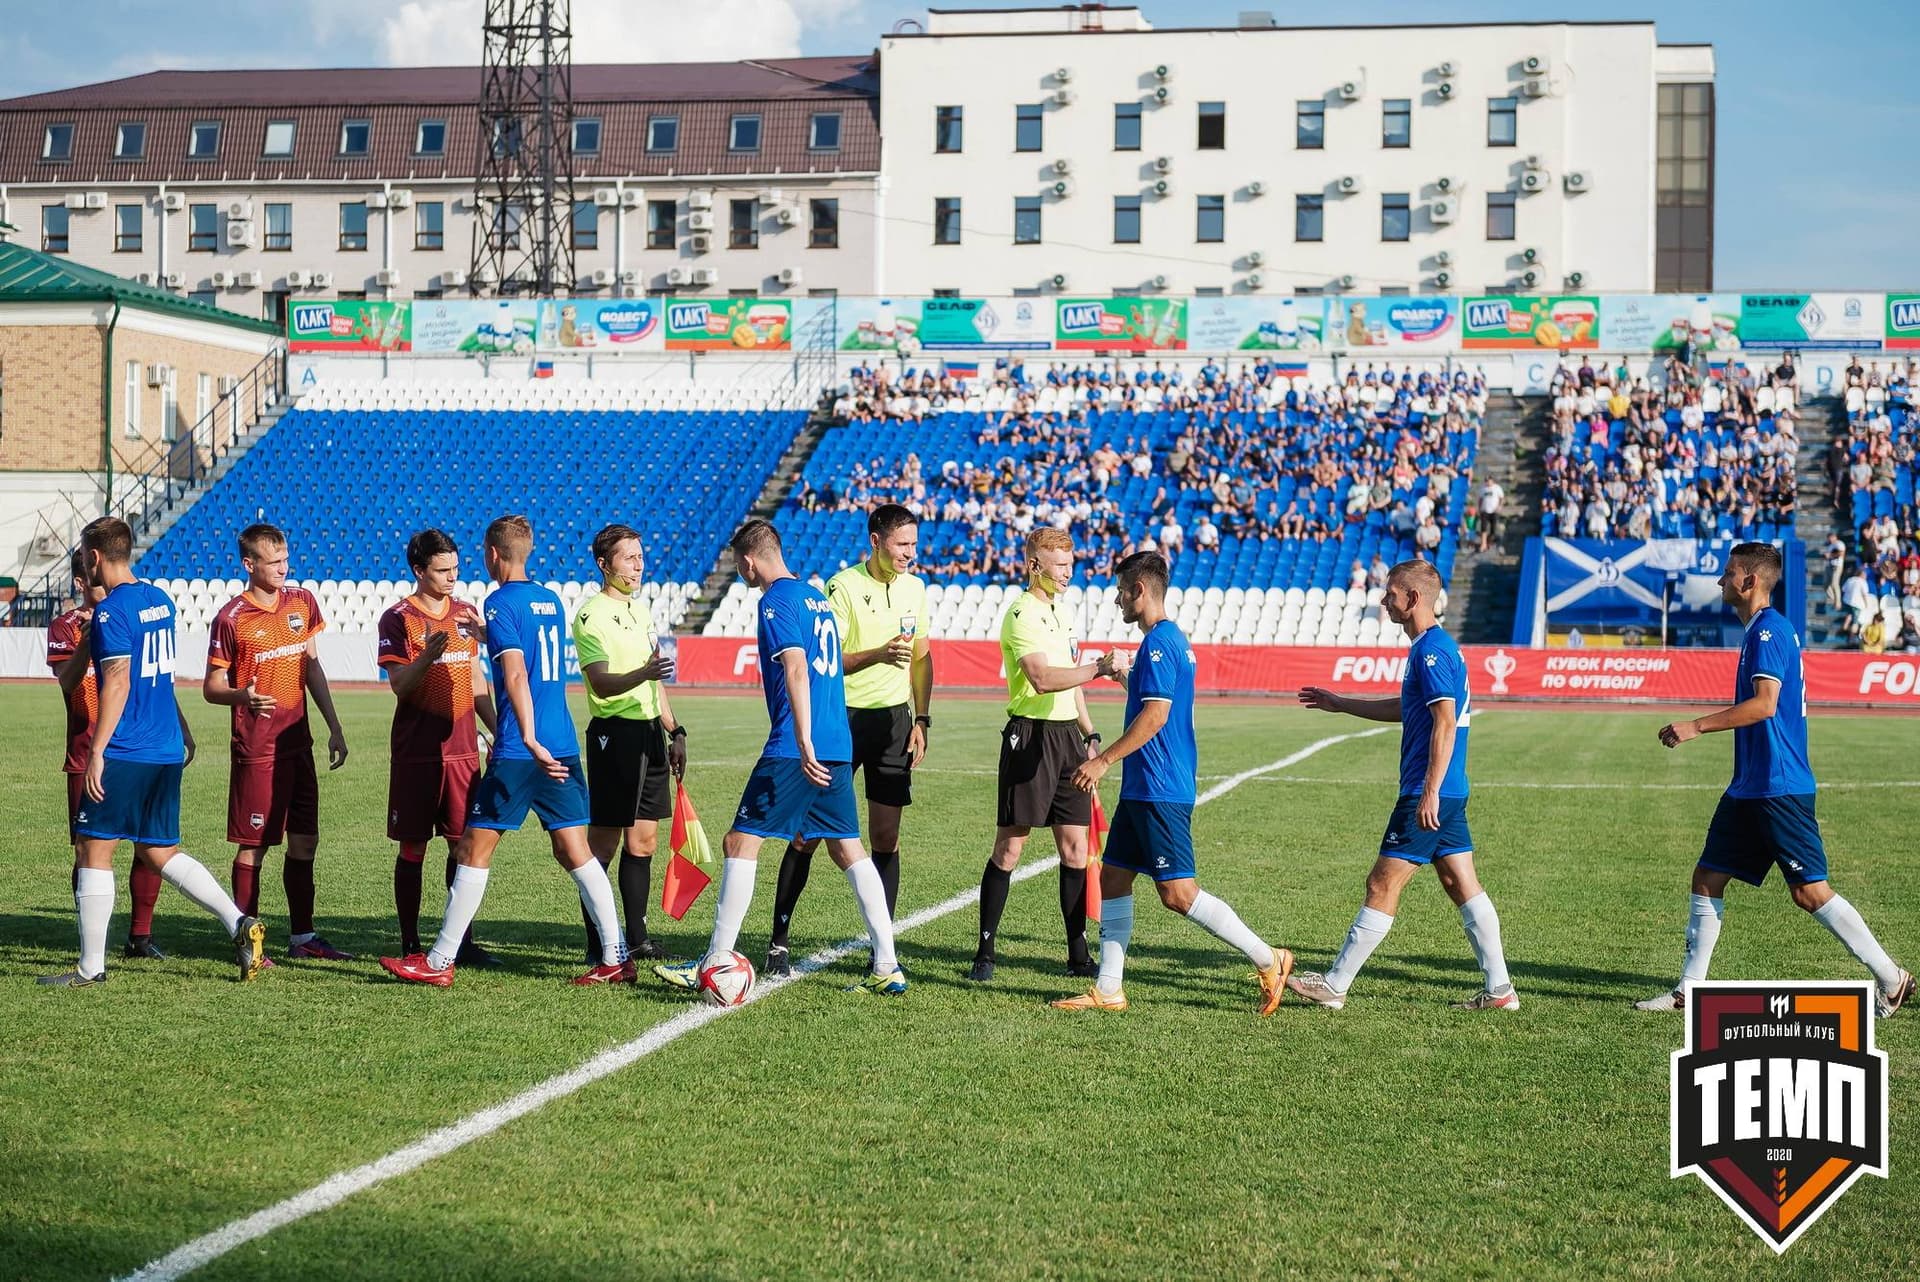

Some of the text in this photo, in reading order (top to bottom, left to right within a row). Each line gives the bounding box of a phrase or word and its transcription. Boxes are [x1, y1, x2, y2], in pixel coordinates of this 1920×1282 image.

[141, 628, 176, 687] 44
[538, 625, 559, 681] 11
[812, 616, 838, 678] 30
[1546, 657, 1671, 672] КУБОК РОССИИ
[1541, 674, 1645, 690] ПО ФУТБОЛУ
